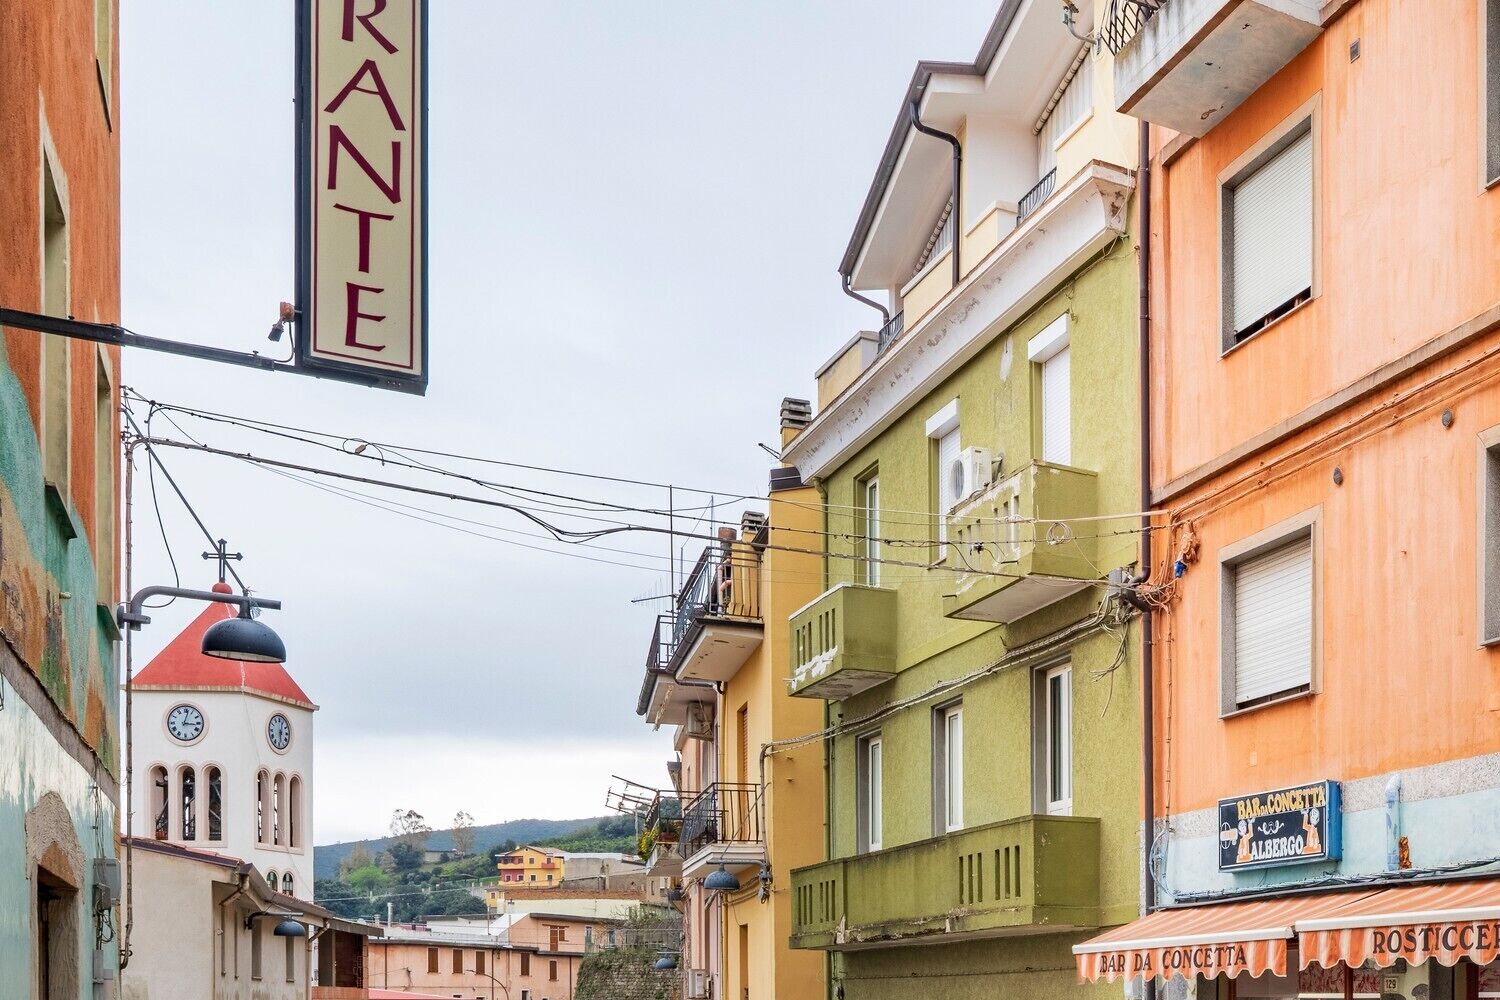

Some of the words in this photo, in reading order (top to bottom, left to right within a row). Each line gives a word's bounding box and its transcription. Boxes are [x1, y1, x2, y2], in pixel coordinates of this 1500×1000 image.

[1237, 797, 1260, 821] BAR
[1267, 786, 1326, 815] CONCETTA
[1251, 834, 1304, 860] ALBERGO
[1099, 954, 1126, 973] BAR
[1133, 952, 1153, 971] DA
[1162, 944, 1248, 970] CONCETTA
[1385, 979, 1397, 989] 129
